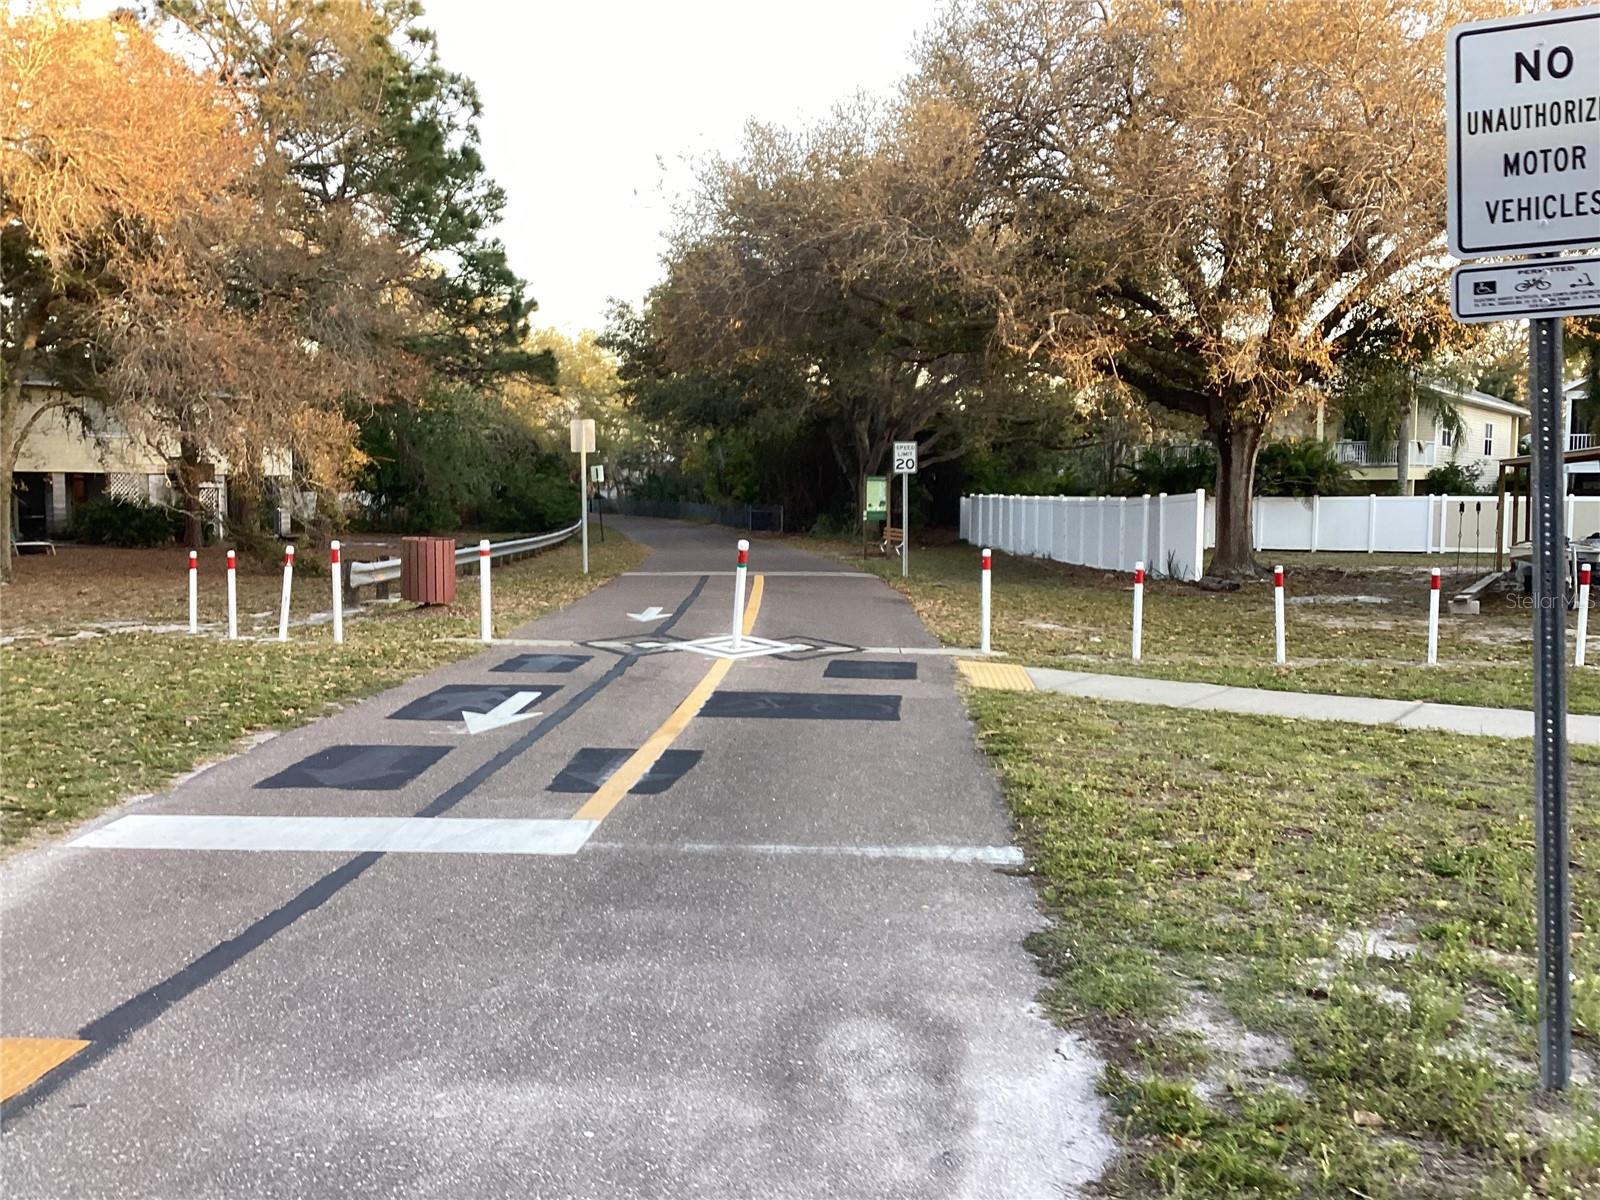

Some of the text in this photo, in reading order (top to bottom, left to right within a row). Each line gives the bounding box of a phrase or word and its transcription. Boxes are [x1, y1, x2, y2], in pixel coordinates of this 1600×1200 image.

[1515, 45, 1574, 84] NO
[1467, 96, 1600, 136] UNAUTHORIZ
[1503, 145, 1587, 178] MOTOR
[1485, 190, 1600, 225] VEHICLES
[896, 458, 915, 470] 20
